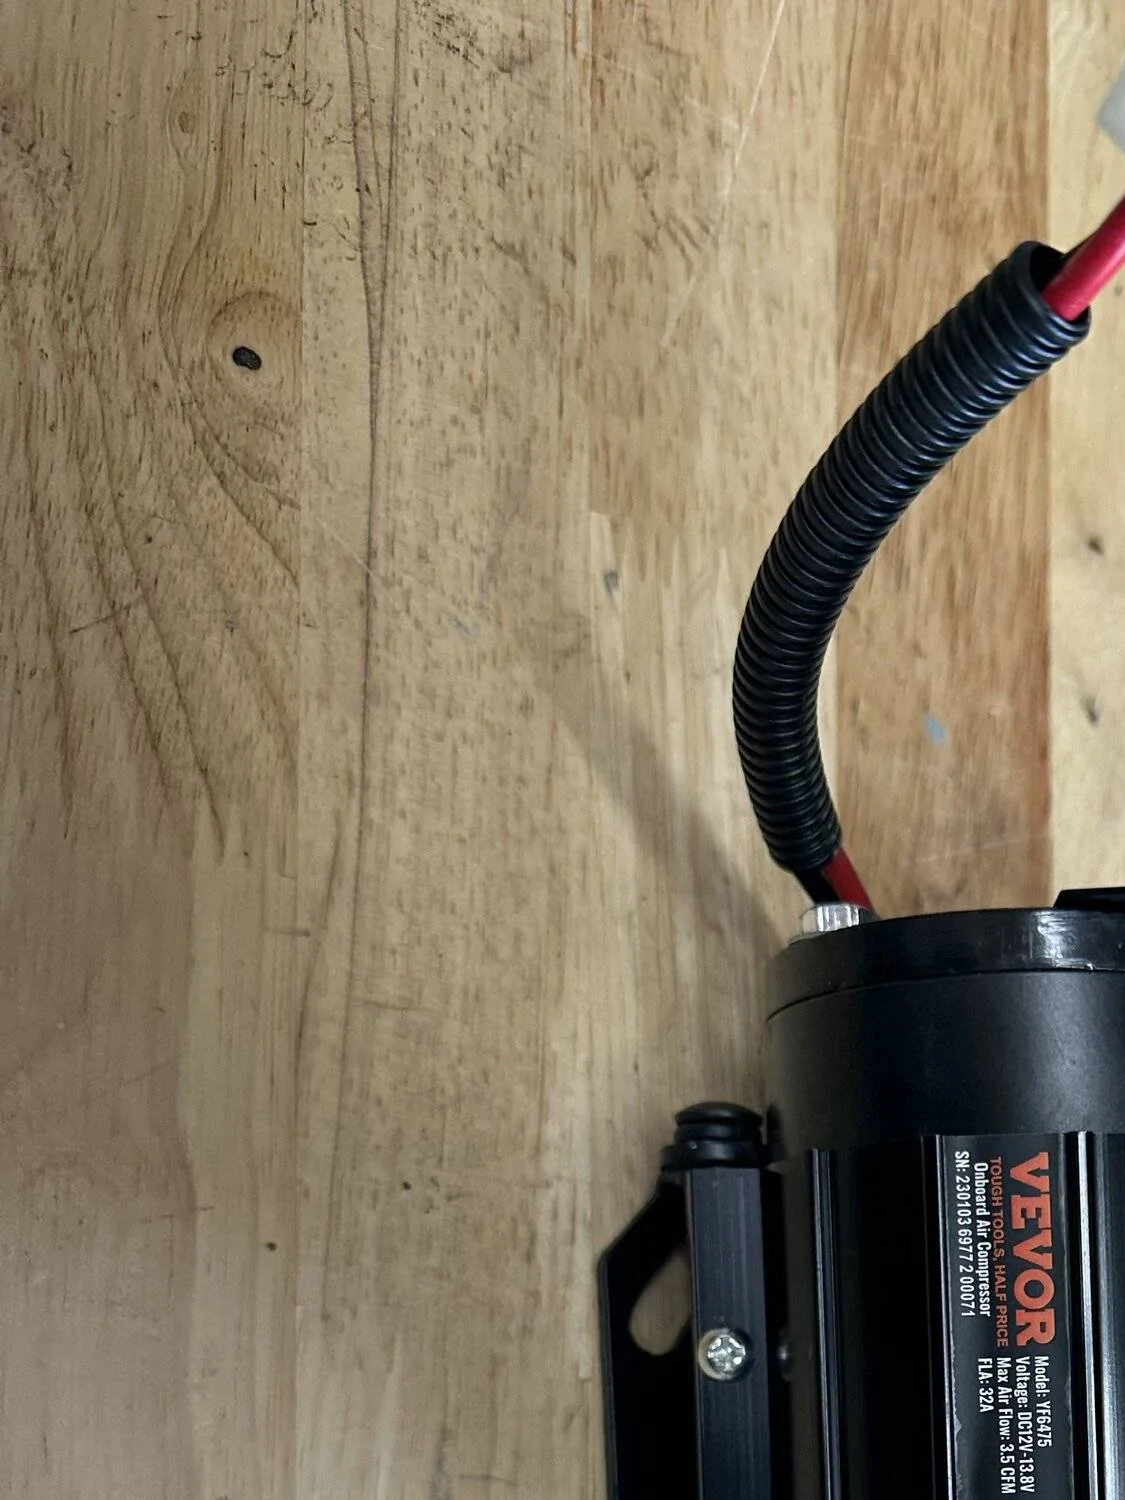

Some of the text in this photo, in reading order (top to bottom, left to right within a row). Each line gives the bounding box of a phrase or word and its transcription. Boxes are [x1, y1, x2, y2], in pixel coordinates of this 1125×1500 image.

[955, 1151, 975, 1317] SN: 230103 6977 2 00071
[974, 1162, 991, 1316] Onboard Air Compressor
[990, 1157, 1008, 1347] TOUGH TOOLS, HALF PRICE
[1010, 1152, 1055, 1347] VEVOR
[978, 1358, 994, 1412] FLA: 32A
[997, 1357, 1016, 1494] Max Air Flow: 3.5 CFM
[1014, 1356, 1034, 1492] Voltage: DC12V-13.8V
[1034, 1356, 1052, 1447] Model: YF6475
